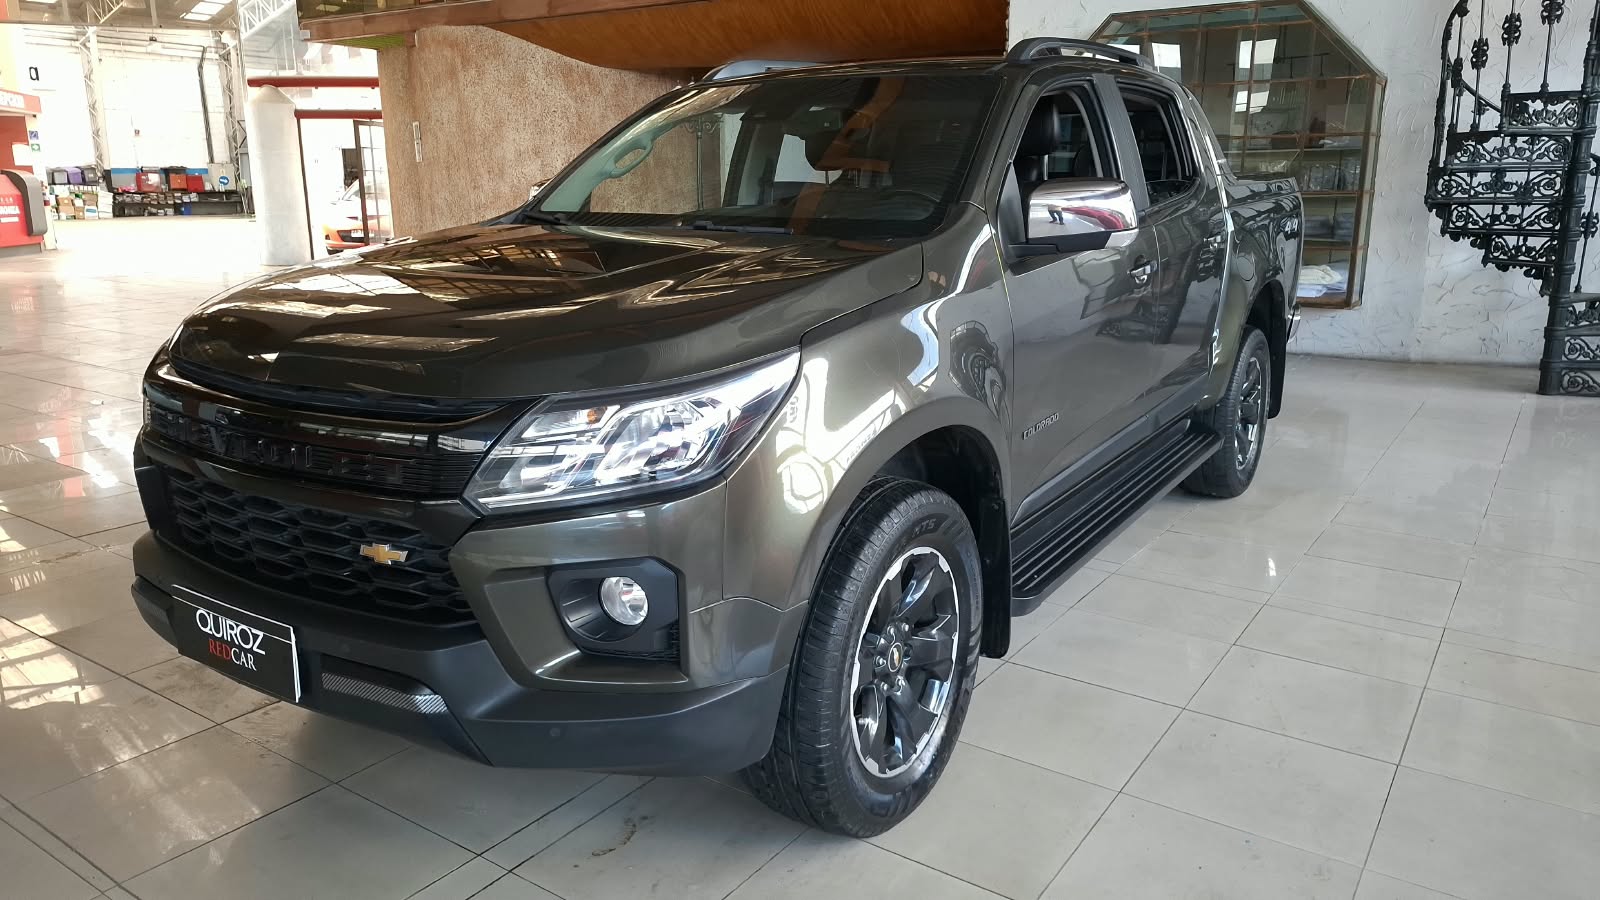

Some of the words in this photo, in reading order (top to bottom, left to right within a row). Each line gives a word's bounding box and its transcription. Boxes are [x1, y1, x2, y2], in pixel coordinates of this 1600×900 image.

[1023, 412, 1060, 440] COLORADO
[196, 609, 265, 655] QUIROZ
[208, 638, 258, 671] REDCAR
